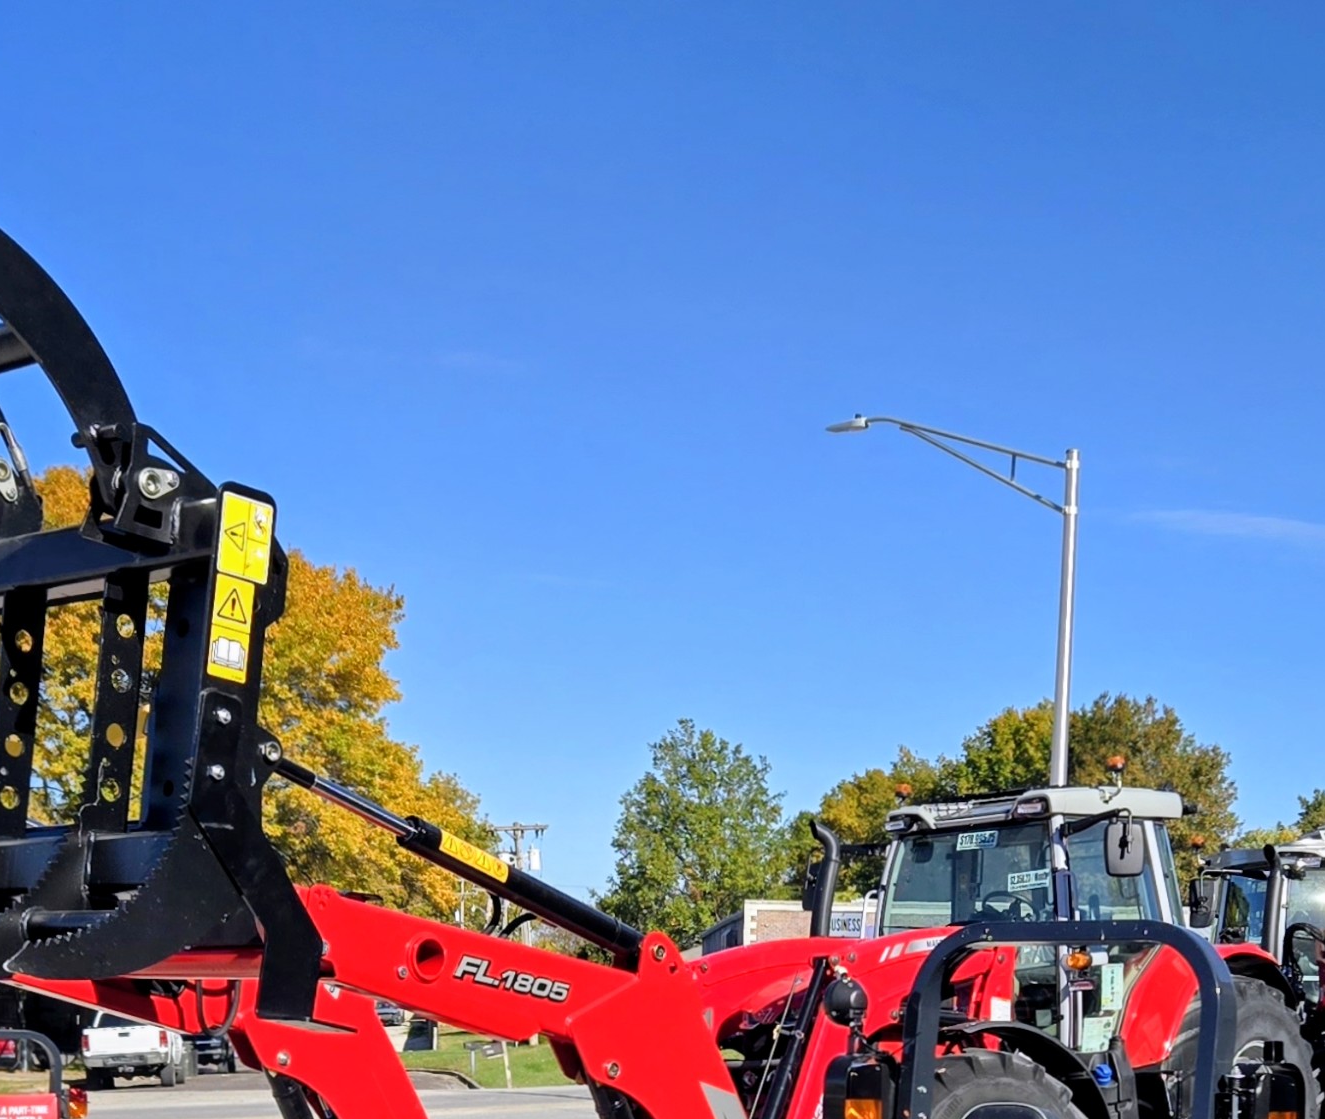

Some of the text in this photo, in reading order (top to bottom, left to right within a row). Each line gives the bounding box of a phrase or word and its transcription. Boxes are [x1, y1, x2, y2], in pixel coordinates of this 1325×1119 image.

[832, 917, 861, 932] USINESS
[453, 954, 571, 1003] FL.1805
[0, 1105, 8, 1115] A
[8, 1104, 49, 1115] PART-TIME
